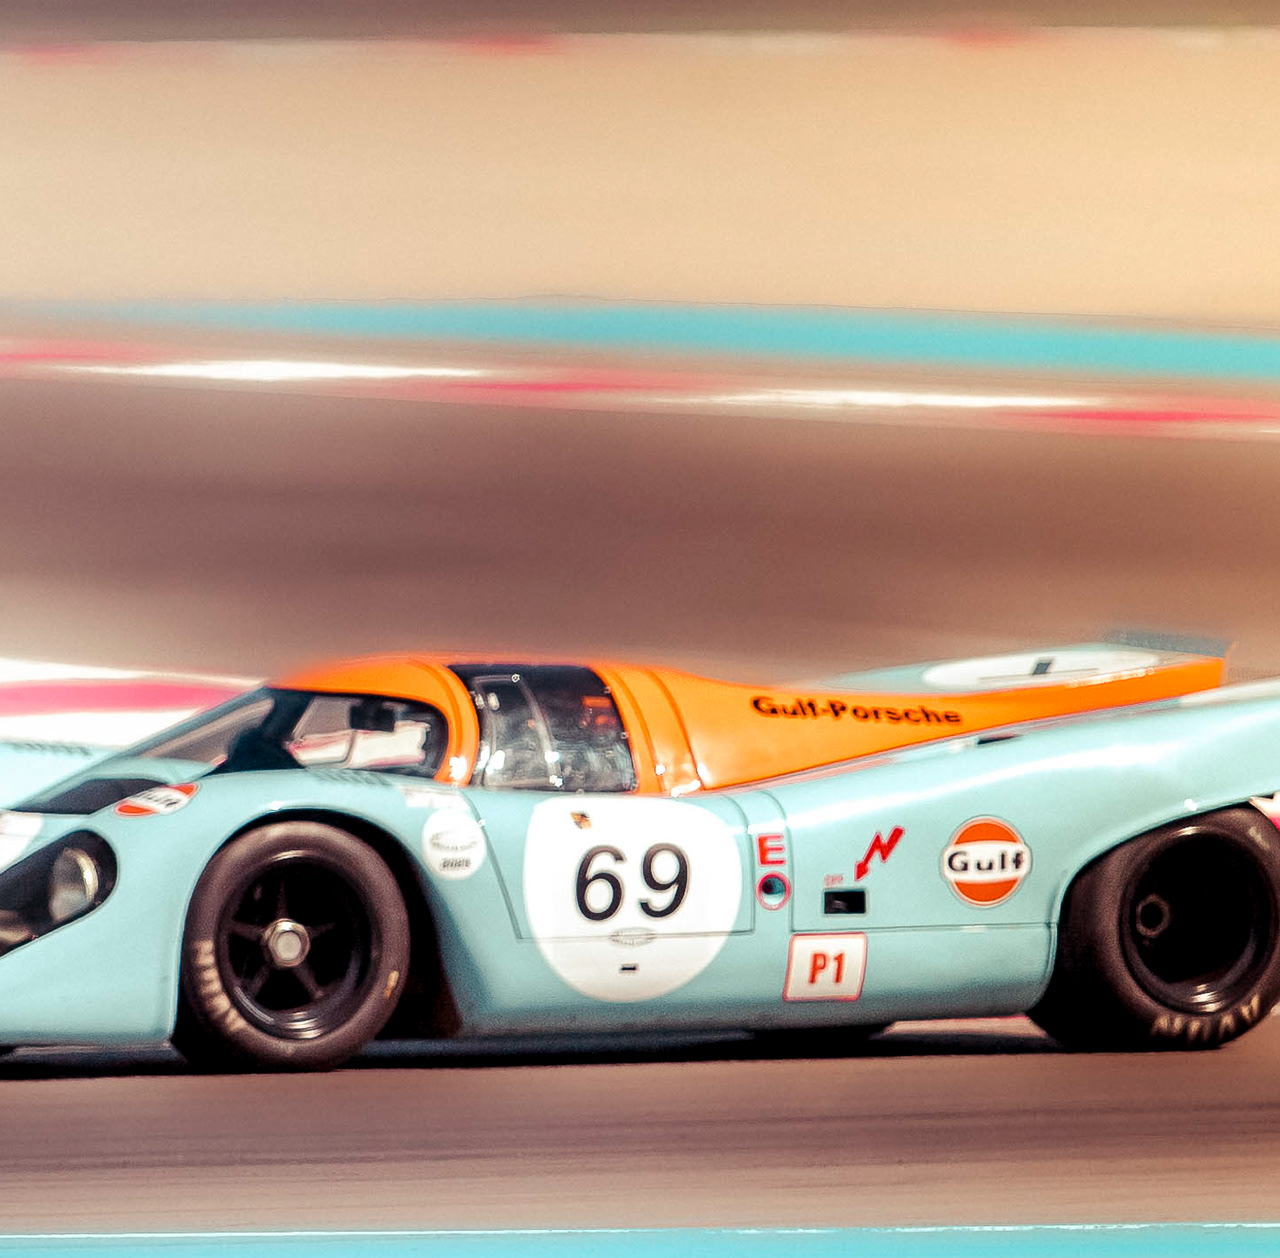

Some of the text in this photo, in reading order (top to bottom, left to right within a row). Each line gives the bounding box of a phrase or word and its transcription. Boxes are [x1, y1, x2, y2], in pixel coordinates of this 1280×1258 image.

[751, 696, 961, 724] Gulf-Porsche
[756, 833, 786, 866] E
[947, 850, 1025, 872] Gulf
[575, 843, 689, 921] 69
[808, 951, 845, 984] P1
